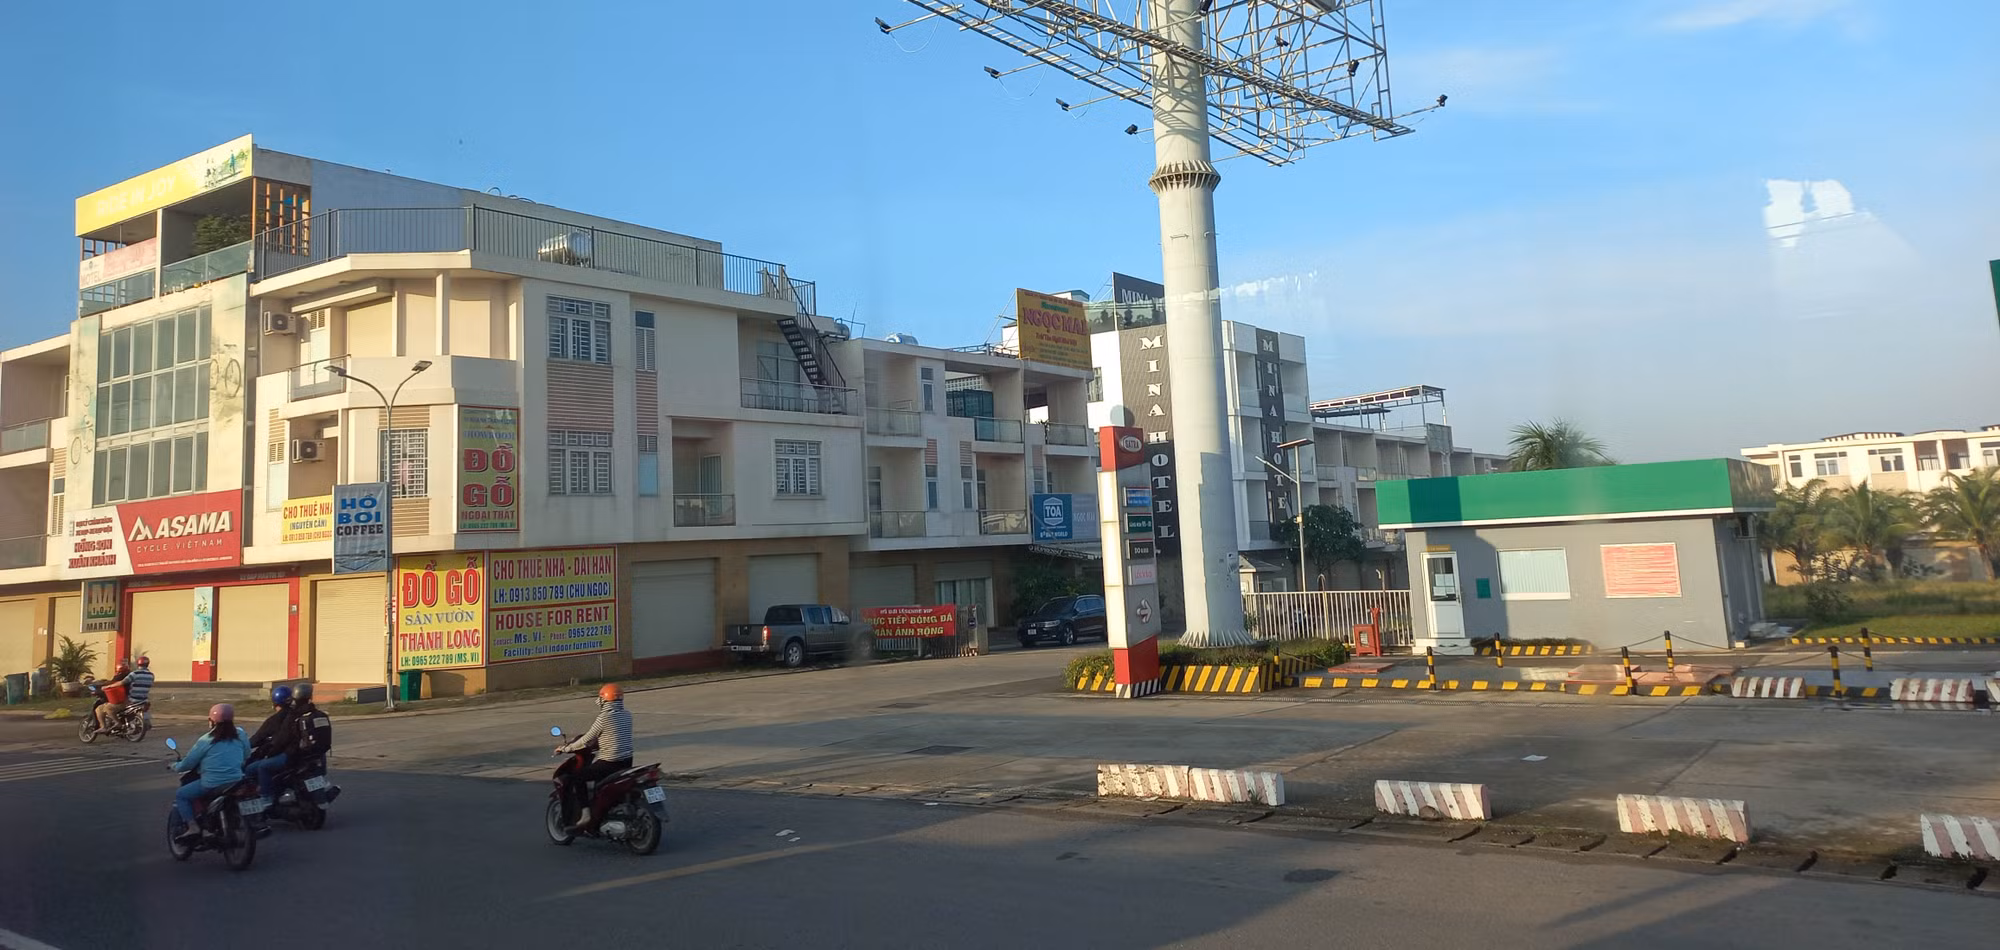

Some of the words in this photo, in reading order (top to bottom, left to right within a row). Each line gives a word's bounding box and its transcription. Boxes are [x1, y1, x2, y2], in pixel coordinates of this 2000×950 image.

[1140, 335, 1165, 416] MINA
[1148, 431, 1175, 538] HOTEL
[1271, 430, 1287, 522] HOTE
[283, 505, 298, 519] CHO
[1045, 506, 1062, 517] TOA
[155, 511, 233, 539] ASAMA
[336, 524, 384, 536] COFFEE
[137, 543, 168, 553] CYCLE
[493, 559, 515, 580] CHO
[592, 555, 611, 579] HẠN
[494, 588, 507, 603] LH:
[509, 587, 530, 602] 0913
[533, 586, 548, 601] 850
[549, 585, 564, 599] 789
[587, 582, 611, 599] NGỌC)
[86, 621, 116, 631] MARTIN
[405, 611, 433, 626] SÂN
[436, 608, 475, 624] VƯỜN
[495, 612, 543, 630] HOUSE
[547, 609, 573, 626] FOR
[576, 606, 610, 623] RENT
[887, 614, 907, 625] TIẾP
[910, 614, 938, 625] BÓNG
[400, 627, 443, 652] THÀNH
[446, 628, 481, 649] LONG
[514, 633, 531, 644] Ms.
[568, 628, 585, 639] 0965
[586, 627, 599, 637] 222
[600, 625, 612, 635] 789
[916, 625, 944, 637] RỘNG
[504, 647, 534, 657] Facility:
[549, 643, 572, 653] indoor
[573, 640, 603, 650] furniture
[401, 657, 411, 667] LH:
[411, 656, 428, 666] 0965
[428, 655, 441, 665] 222
[441, 654, 454, 664] 789
